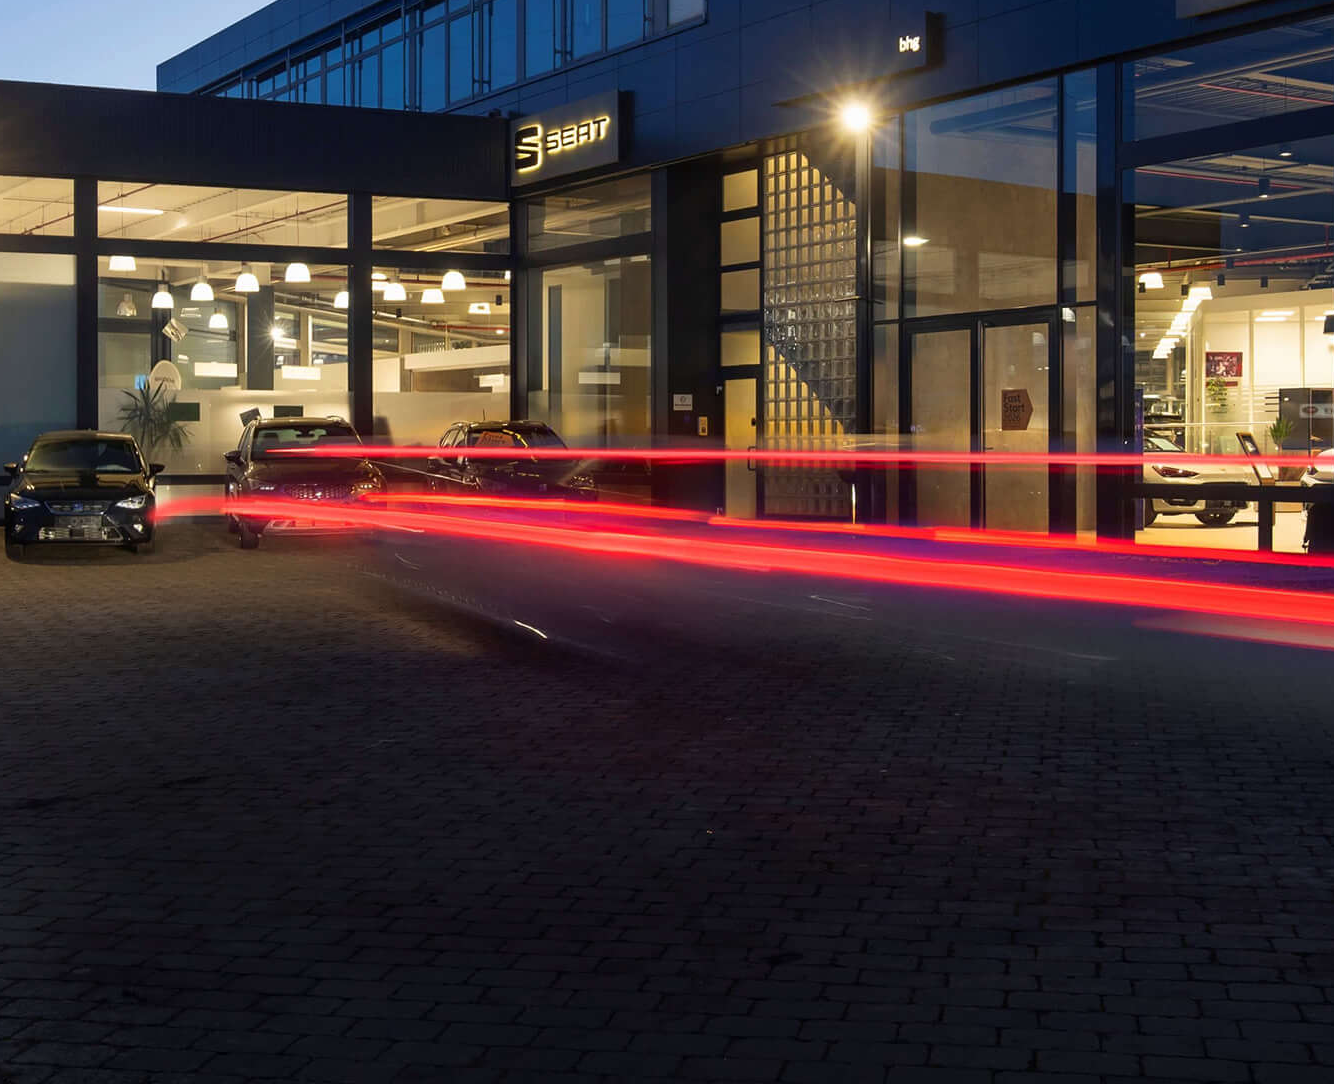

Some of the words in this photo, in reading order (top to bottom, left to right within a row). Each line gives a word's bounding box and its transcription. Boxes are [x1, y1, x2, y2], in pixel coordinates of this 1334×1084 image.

[899, 36, 920, 52] bhg
[545, 117, 608, 151] SEAT
[1003, 403, 1024, 412] Start
